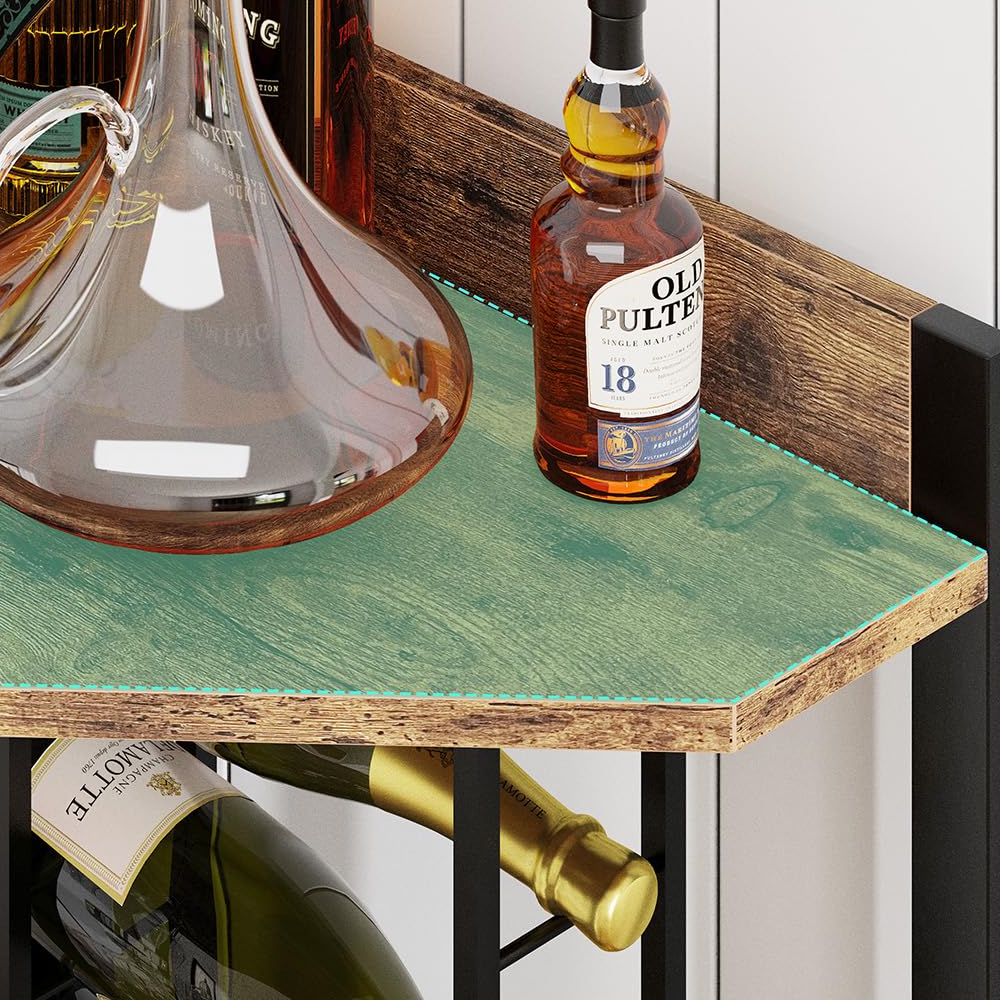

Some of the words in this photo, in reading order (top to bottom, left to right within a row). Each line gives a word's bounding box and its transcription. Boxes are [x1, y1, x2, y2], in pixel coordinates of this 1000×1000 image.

[651, 257, 703, 301] OLD
[602, 337, 639, 348] SINGLE
[644, 334, 673, 347] MALT
[601, 364, 637, 394] 18
[644, 434, 663, 443] THE
[653, 434, 682, 450] PRODUCT
[81, 757, 96, 774] 1760
[112, 753, 175, 796] CHAMPAGNE
